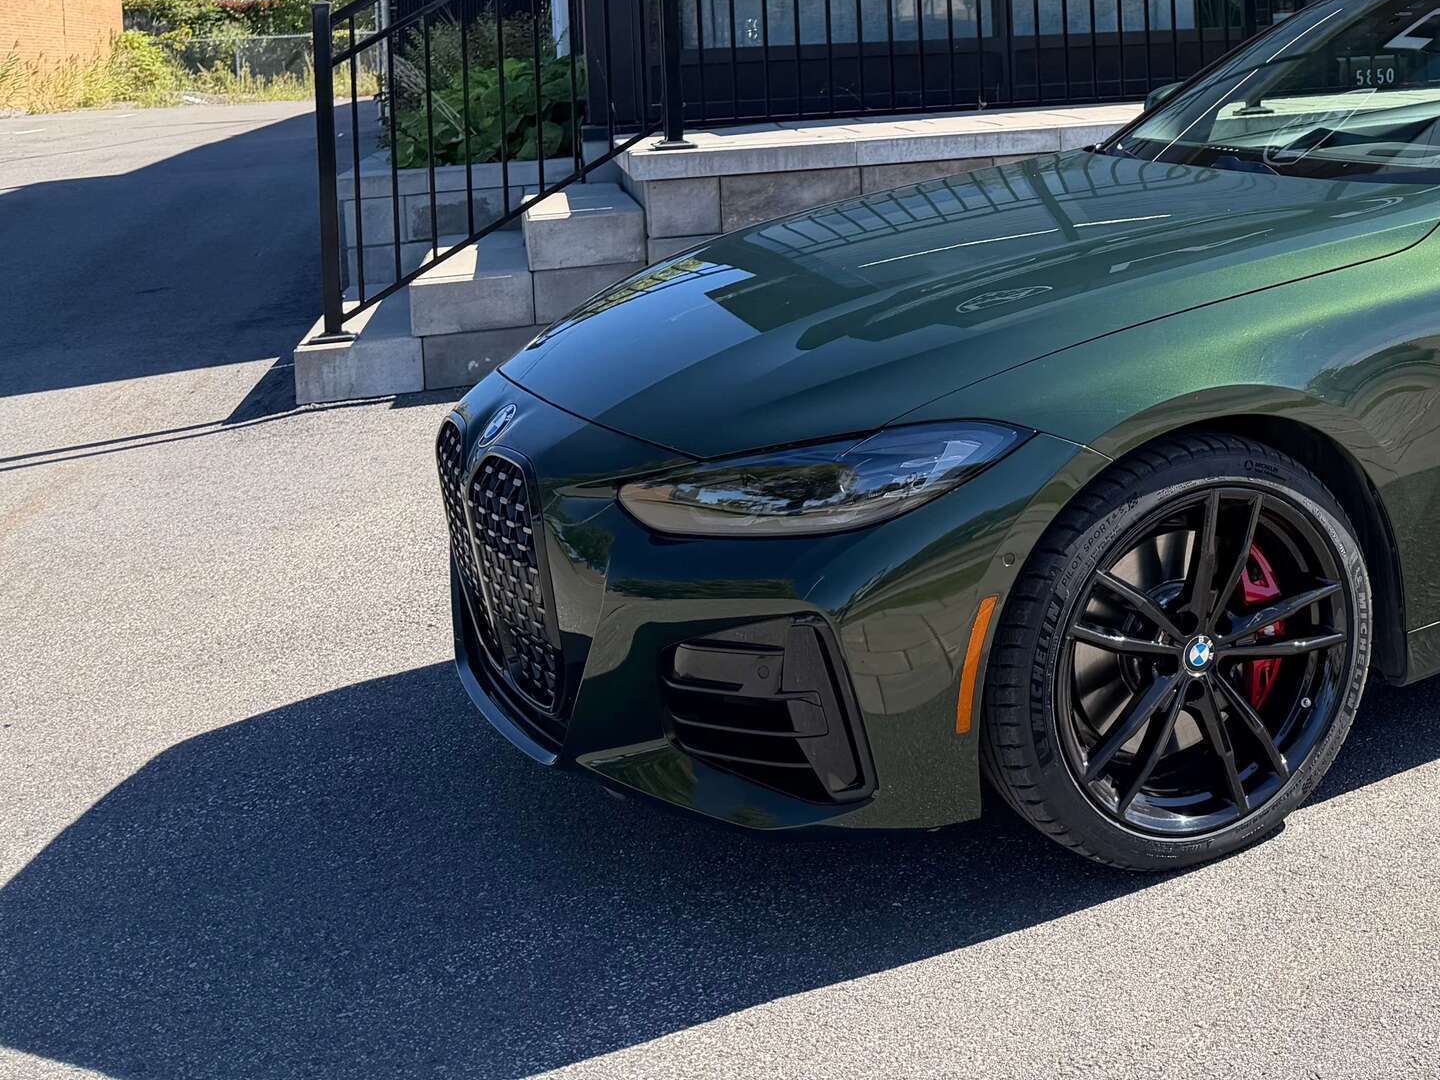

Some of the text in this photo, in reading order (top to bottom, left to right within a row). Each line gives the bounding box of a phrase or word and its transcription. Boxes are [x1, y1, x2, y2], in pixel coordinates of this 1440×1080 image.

[1061, 554, 1083, 587] PILOT
[1083, 519, 1113, 553] SPORT
[1031, 601, 1060, 732] MICHELIN
[1347, 592, 1369, 710] MICHELIN
